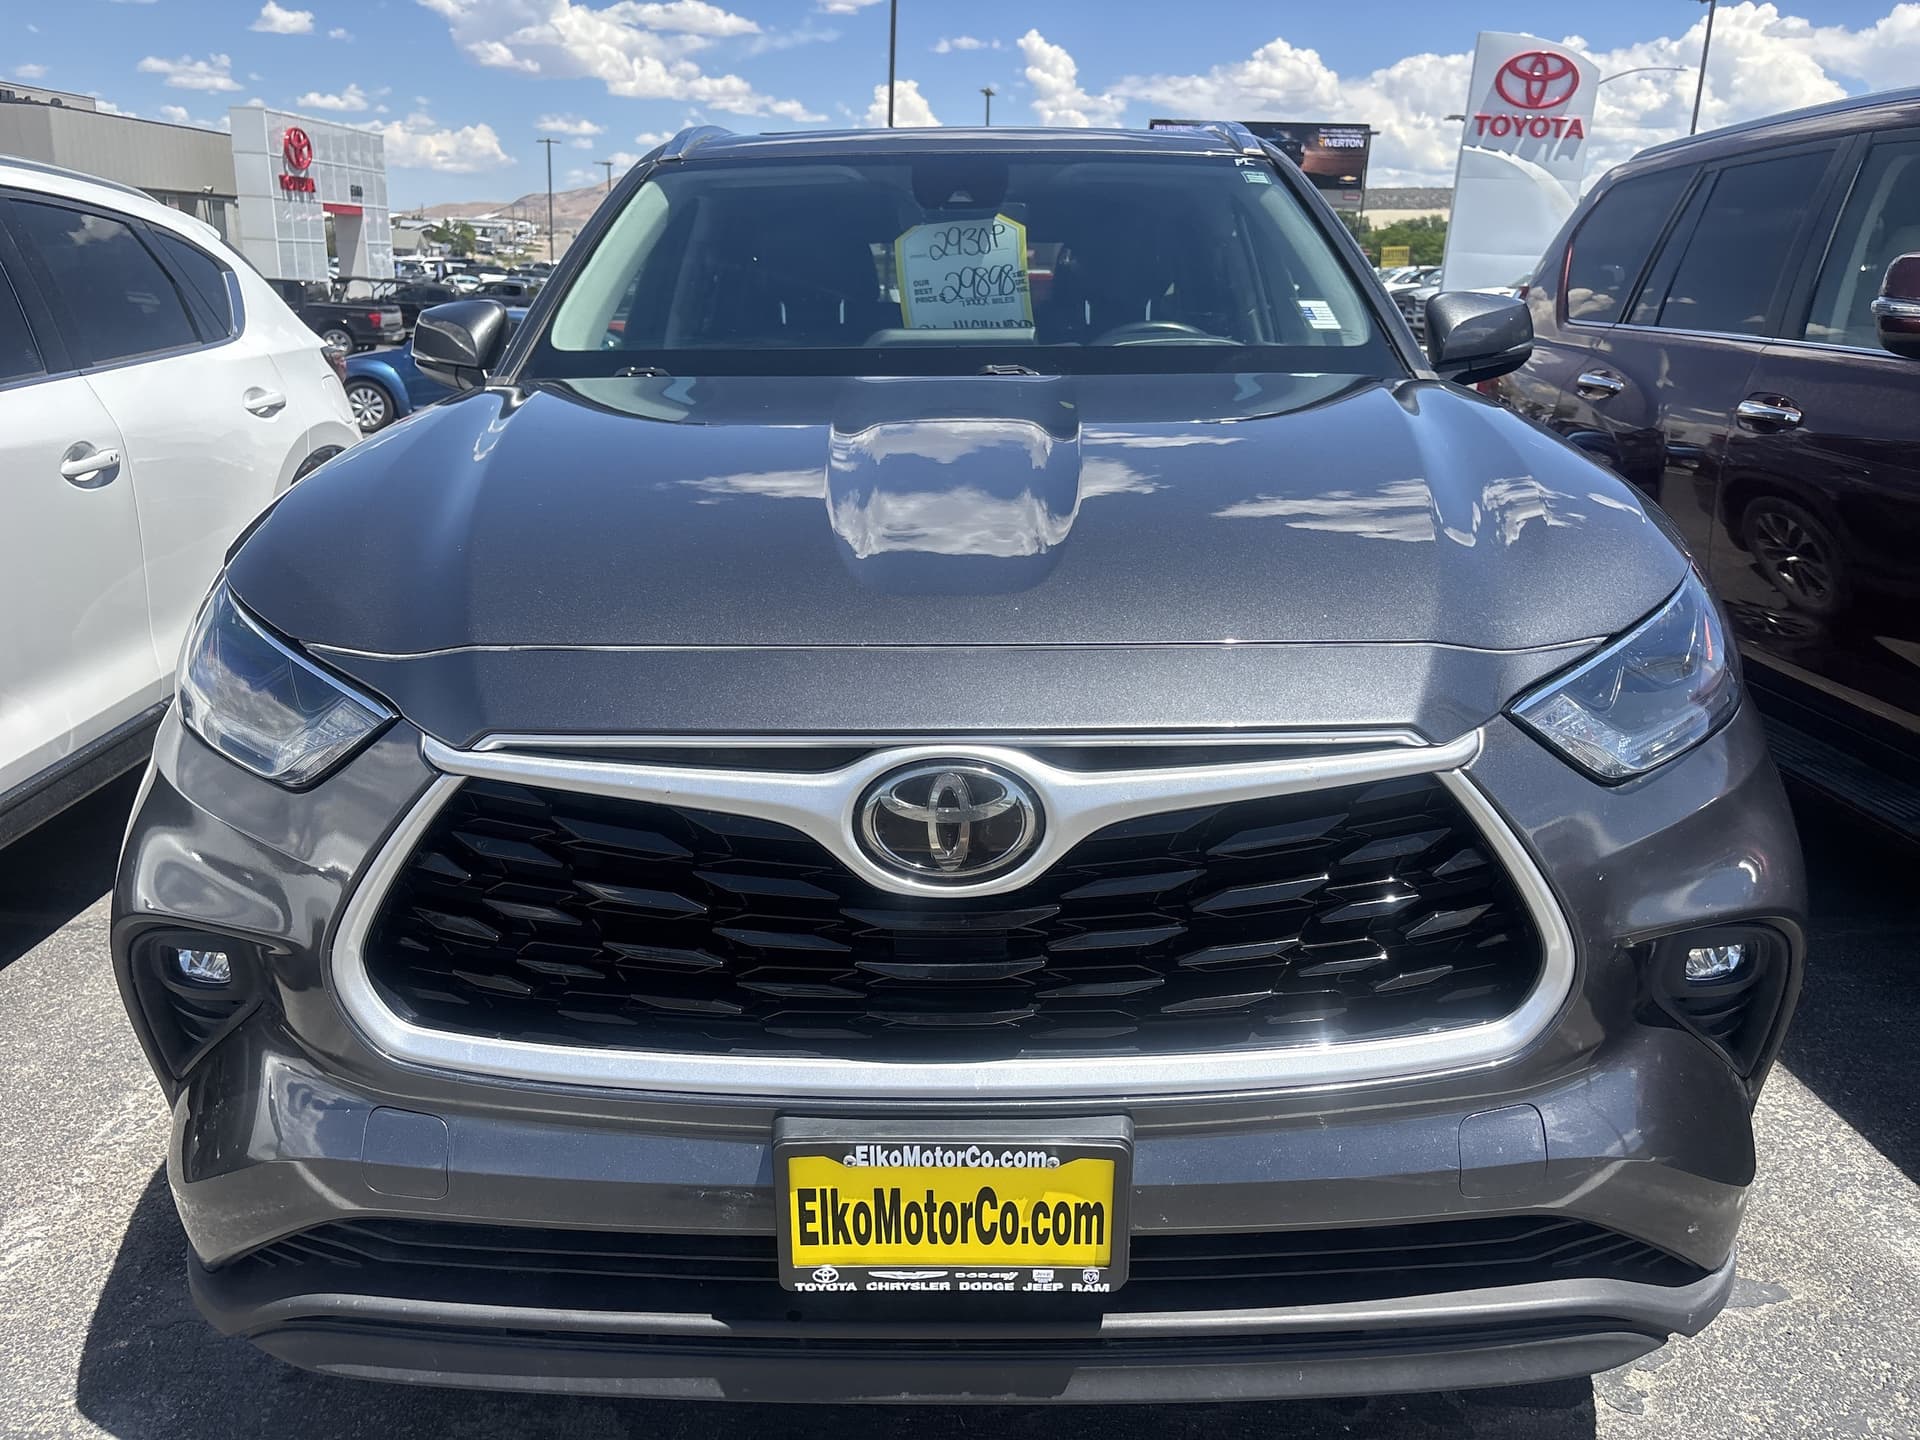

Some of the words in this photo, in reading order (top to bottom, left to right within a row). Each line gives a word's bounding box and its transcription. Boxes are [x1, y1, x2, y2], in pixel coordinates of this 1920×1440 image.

[1474, 114, 1584, 140] TOYOTA
[929, 223, 1006, 261] 2930P
[913, 279, 930, 288] OUR
[914, 287, 933, 296] BEST
[915, 295, 938, 305] PRICE
[854, 1145, 1048, 1168] ElkoMotorCo.com
[796, 1186, 1105, 1246] ElkoMotorCo.com
[794, 1281, 858, 1292] TOYOTA
[866, 1281, 951, 1291] CHRYSLER
[959, 1281, 1015, 1291] DODGE
[1022, 1282, 1064, 1292] JEEP
[1071, 1282, 1110, 1293] RAM
